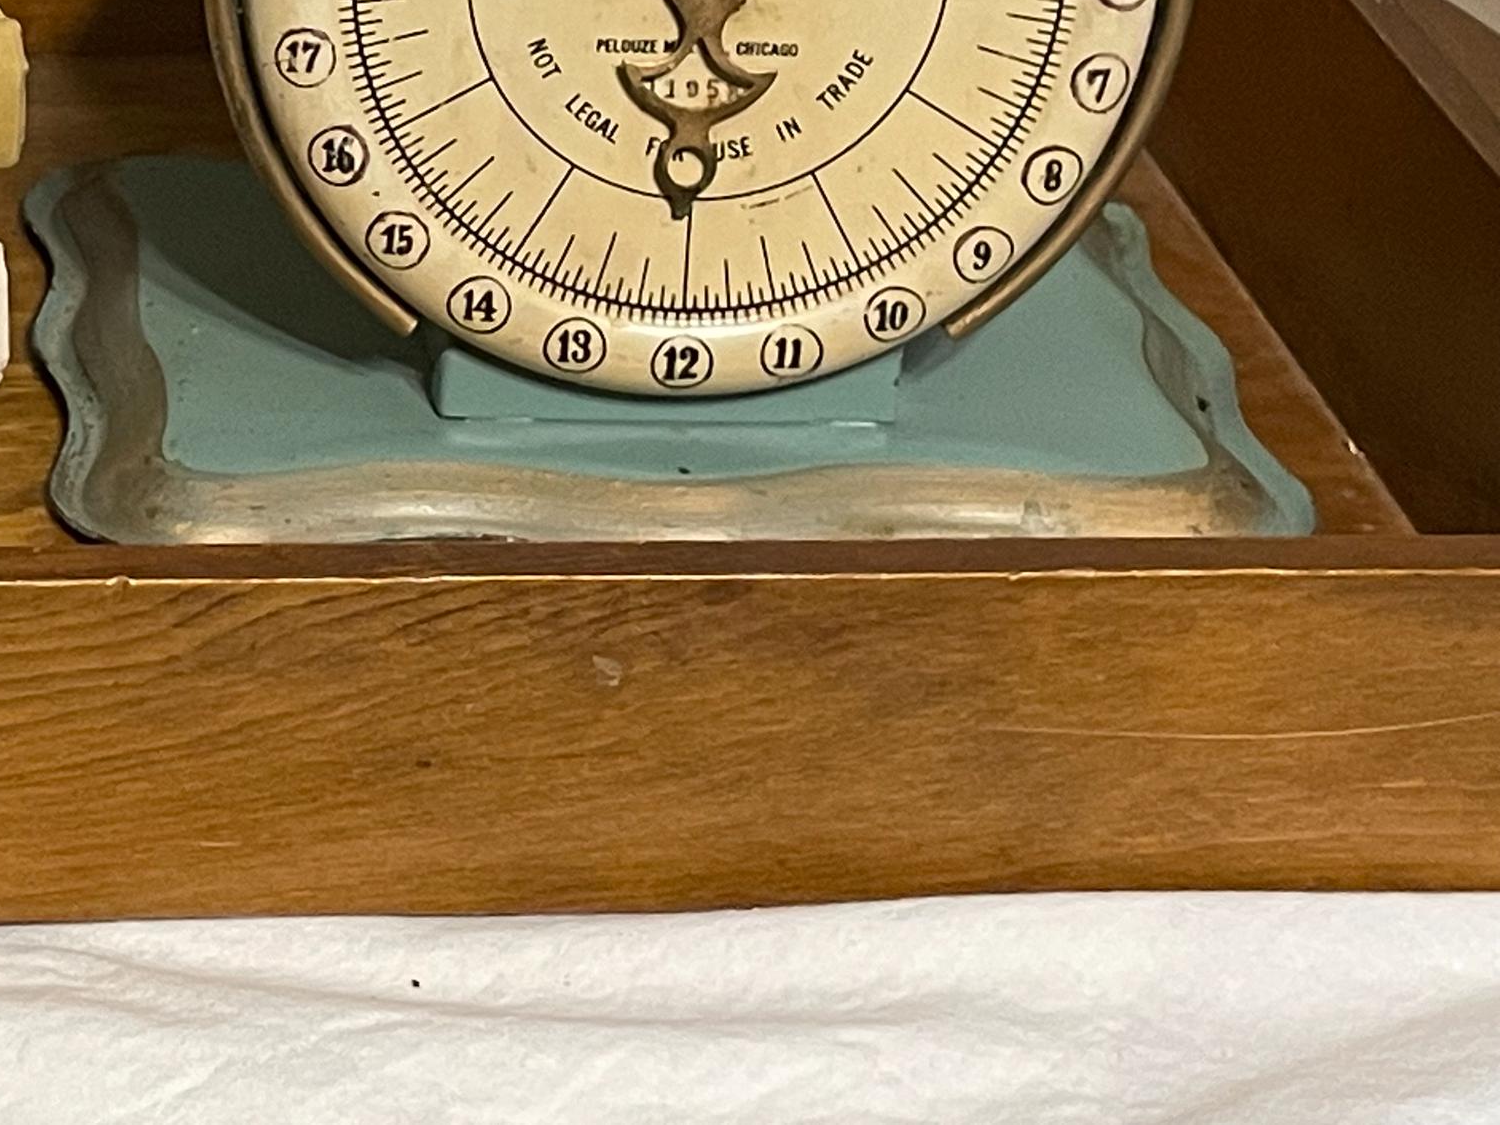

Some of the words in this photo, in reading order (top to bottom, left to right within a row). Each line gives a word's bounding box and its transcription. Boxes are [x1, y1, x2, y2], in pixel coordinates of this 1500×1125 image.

[286, 41, 320, 73] 17
[596, 38, 658, 54] PELOUZE
[735, 40, 800, 57] CHICAGO
[527, 37, 562, 80] NOT
[564, 92, 621, 145] LEGAL
[713, 135, 754, 163] USE
[775, 116, 803, 142] IN
[815, 48, 875, 111] TRADE
[1087, 68, 1110, 103] 7
[322, 136, 355, 174] 16
[1043, 160, 1062, 192] 8
[380, 224, 414, 255] 15
[973, 240, 991, 270] 9
[463, 288, 498, 322] 14
[875, 299, 908, 330] 10
[557, 328, 591, 363] 13
[773, 336, 802, 368] 11
[663, 346, 699, 380] 12
